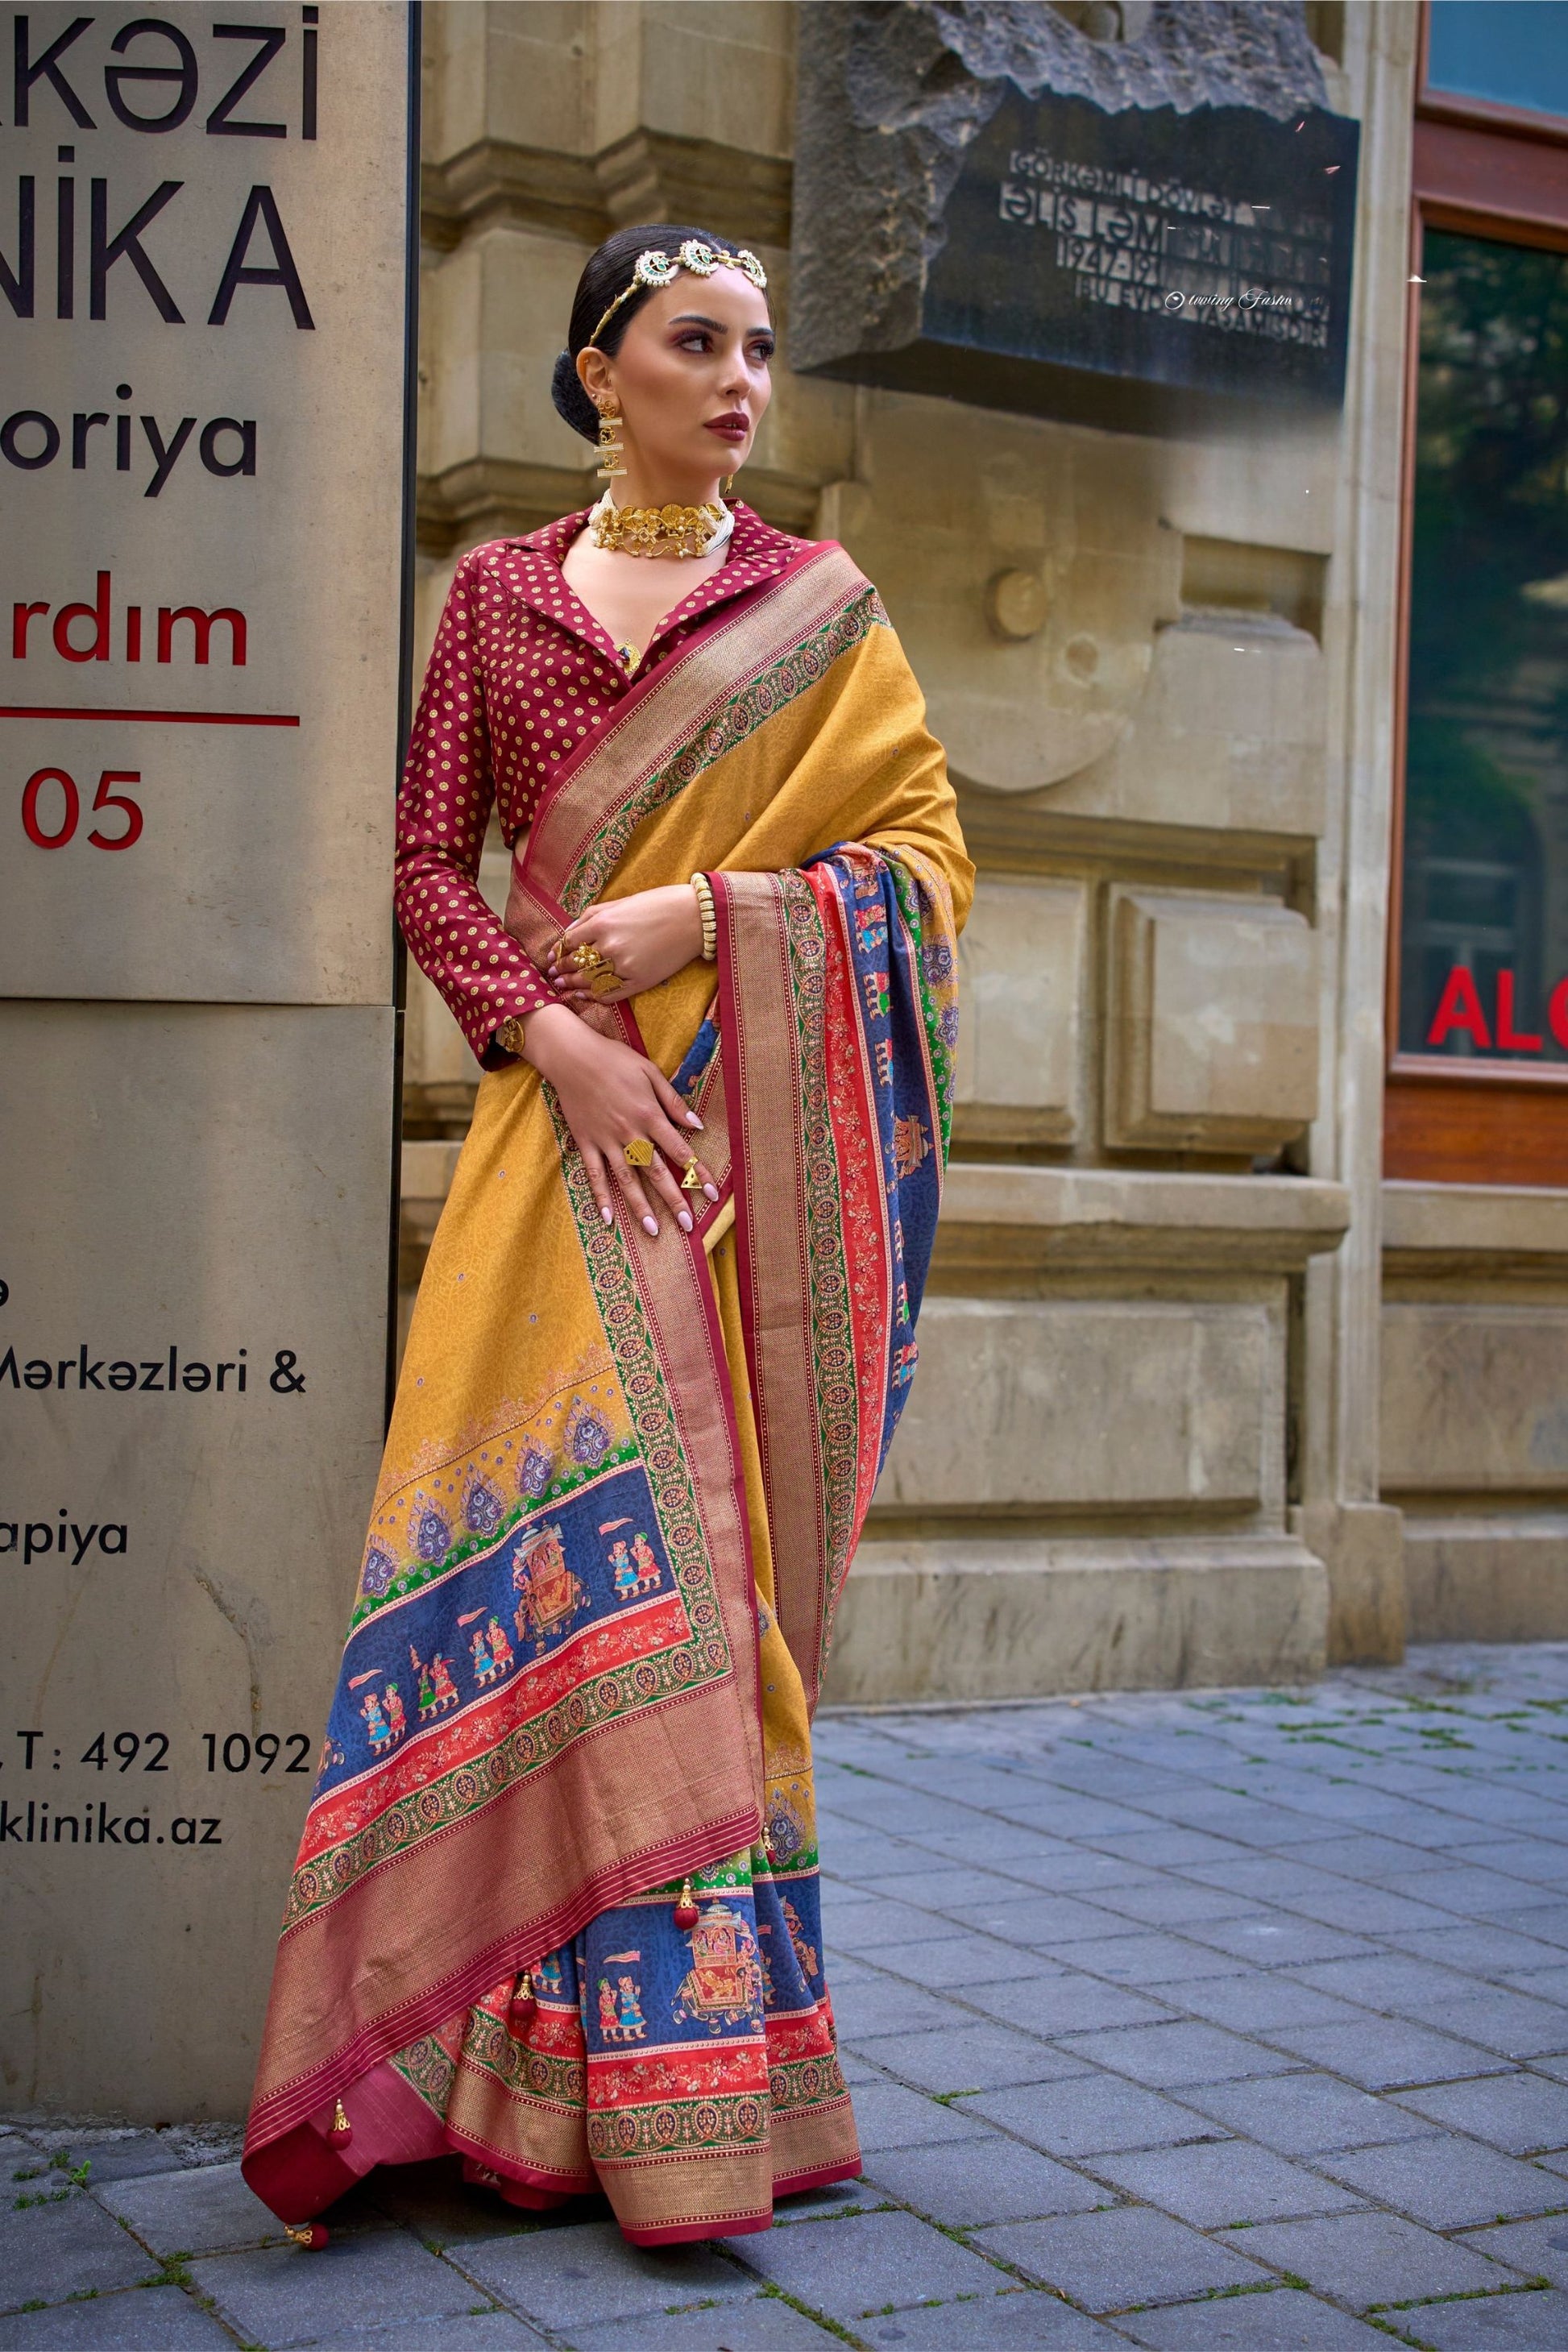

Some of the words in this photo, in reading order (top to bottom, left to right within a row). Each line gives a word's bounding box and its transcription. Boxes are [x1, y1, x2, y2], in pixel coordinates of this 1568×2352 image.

[0, 6, 318, 140] KƏZİ
[0, 384, 256, 498] oriya
[13, 570, 247, 666] rdım
[22, 767, 143, 851] 05
[270, 1350, 306, 1394] &
[0, 1508, 127, 1566] apiya
[80, 1732, 169, 1773] 492
[202, 1732, 310, 1774] 1092
[0, 1800, 222, 1844] klinika.az
